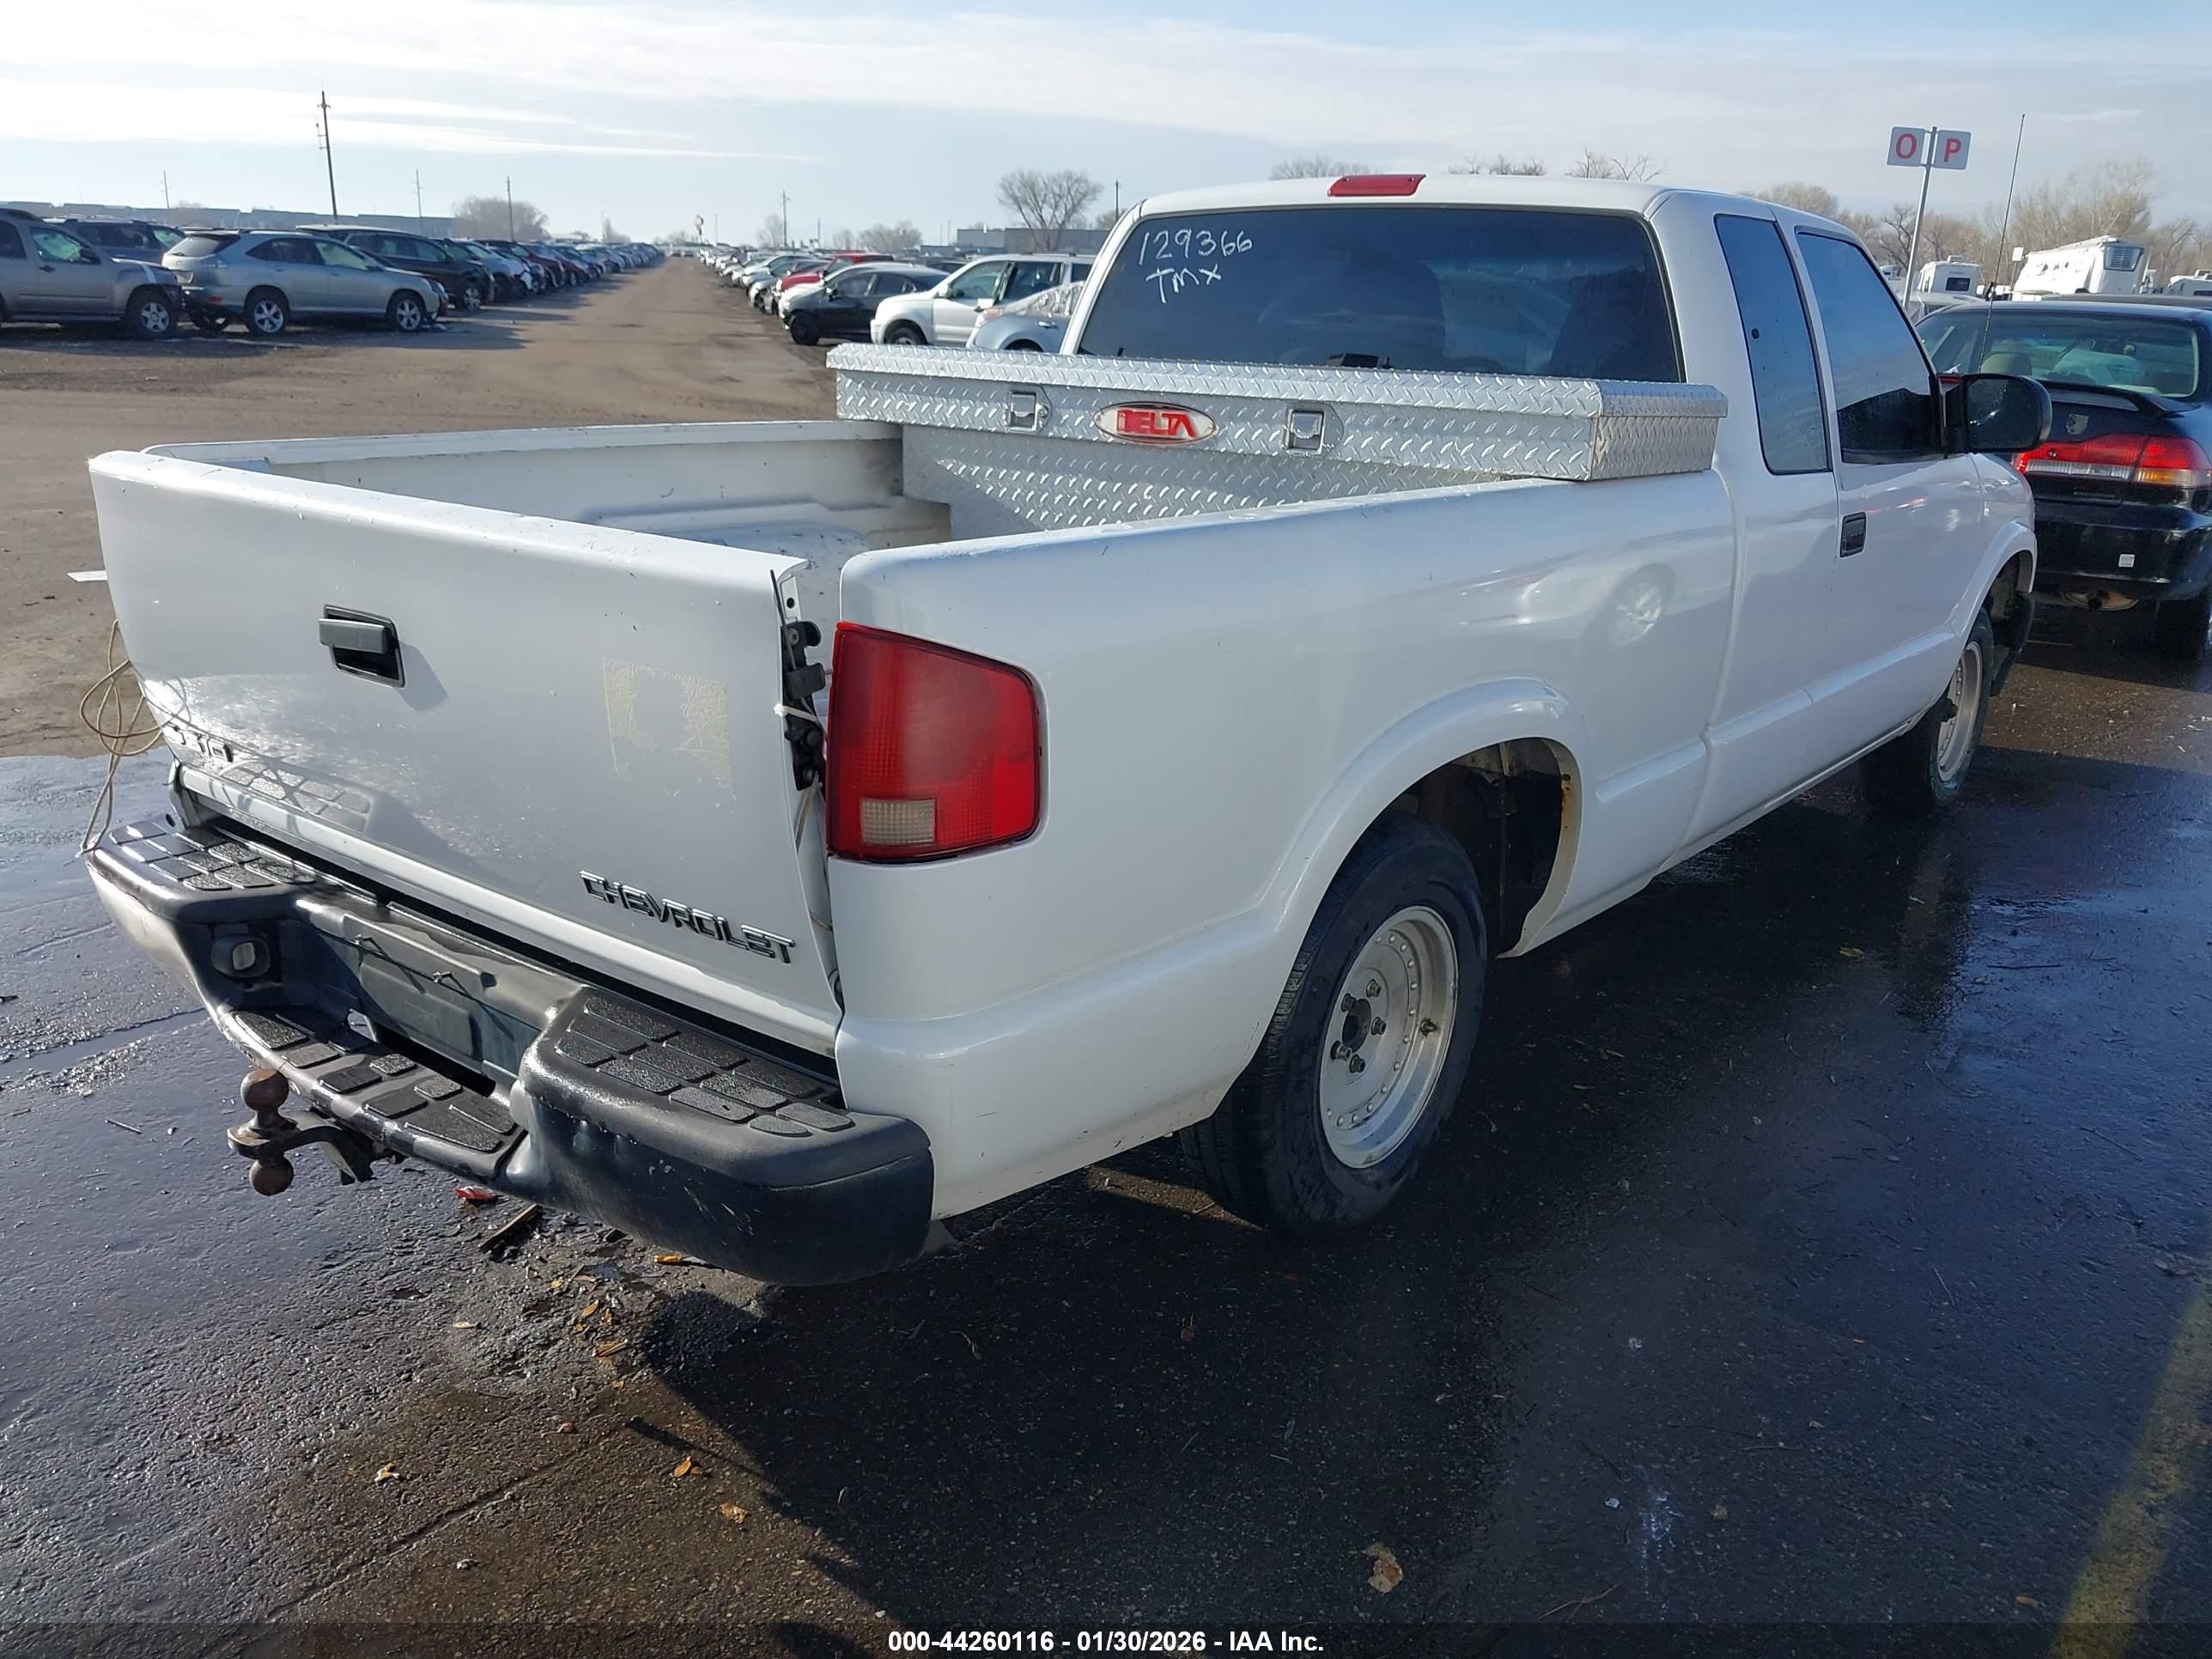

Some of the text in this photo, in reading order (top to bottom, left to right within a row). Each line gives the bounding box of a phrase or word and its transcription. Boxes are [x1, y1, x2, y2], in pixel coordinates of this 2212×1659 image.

[1943, 137, 1962, 163] P
[1138, 228, 1254, 266] 129366
[579, 870, 796, 963] CHEVROLET
